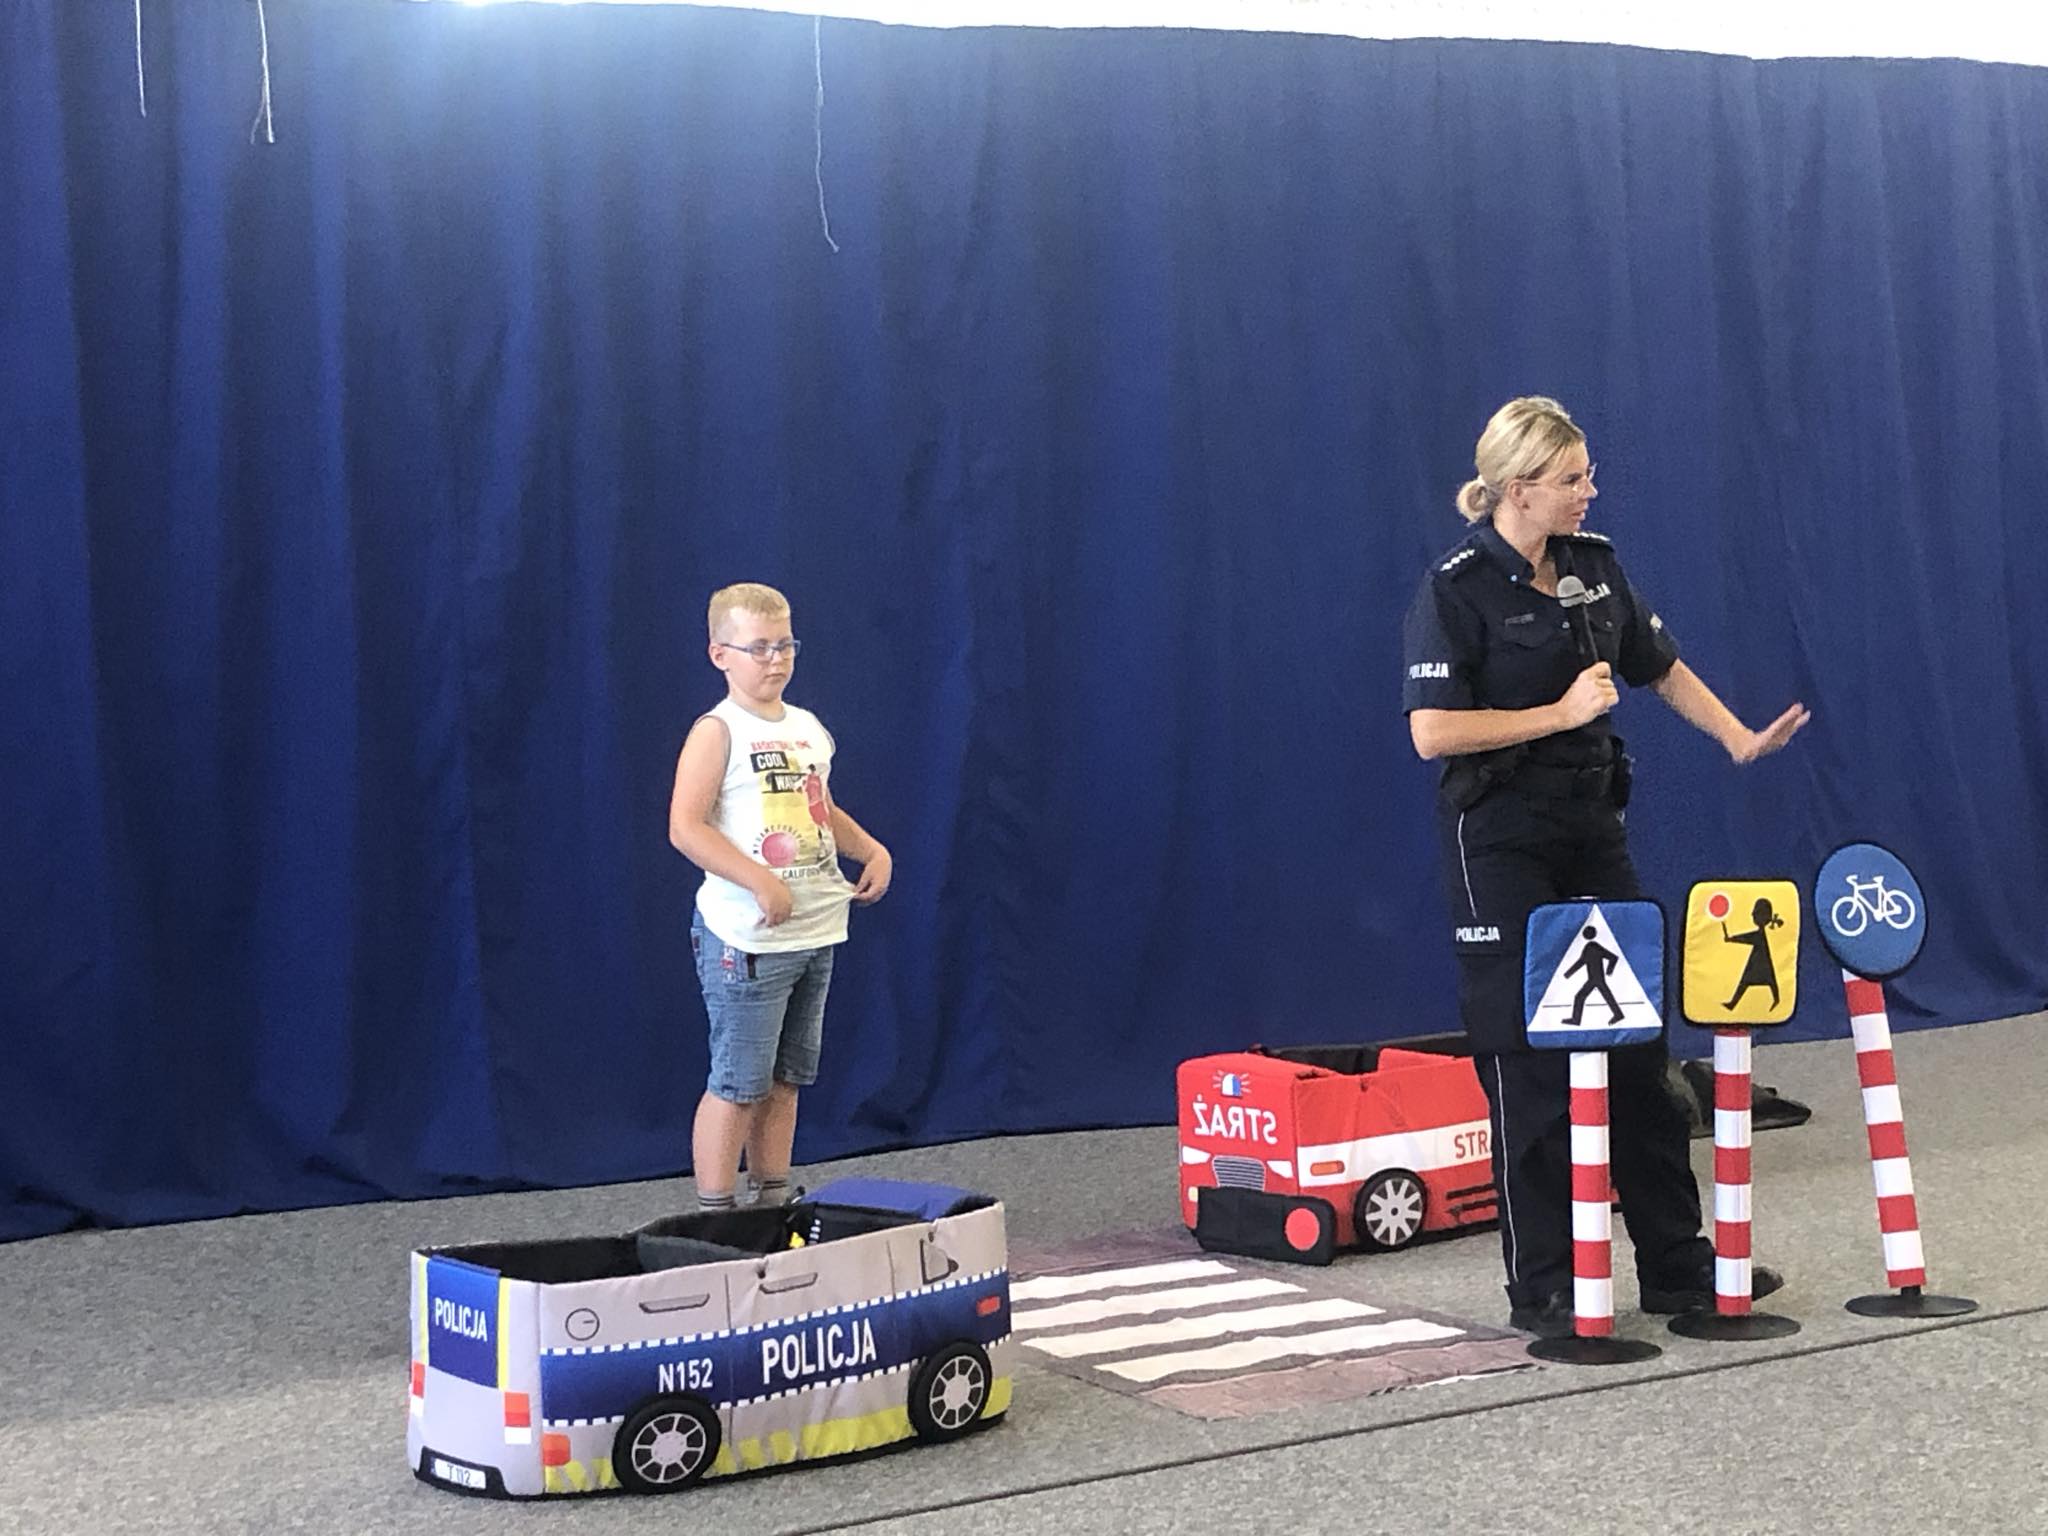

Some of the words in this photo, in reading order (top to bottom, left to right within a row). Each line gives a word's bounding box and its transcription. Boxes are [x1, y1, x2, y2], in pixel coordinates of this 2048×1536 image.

[756, 753, 786, 769] COOL
[1456, 926, 1500, 942] POLICJA
[1454, 1129, 1488, 1159] STR
[434, 1297, 488, 1343] POLICJA
[761, 1318, 877, 1385] POLICJA
[658, 1359, 714, 1392] N152
